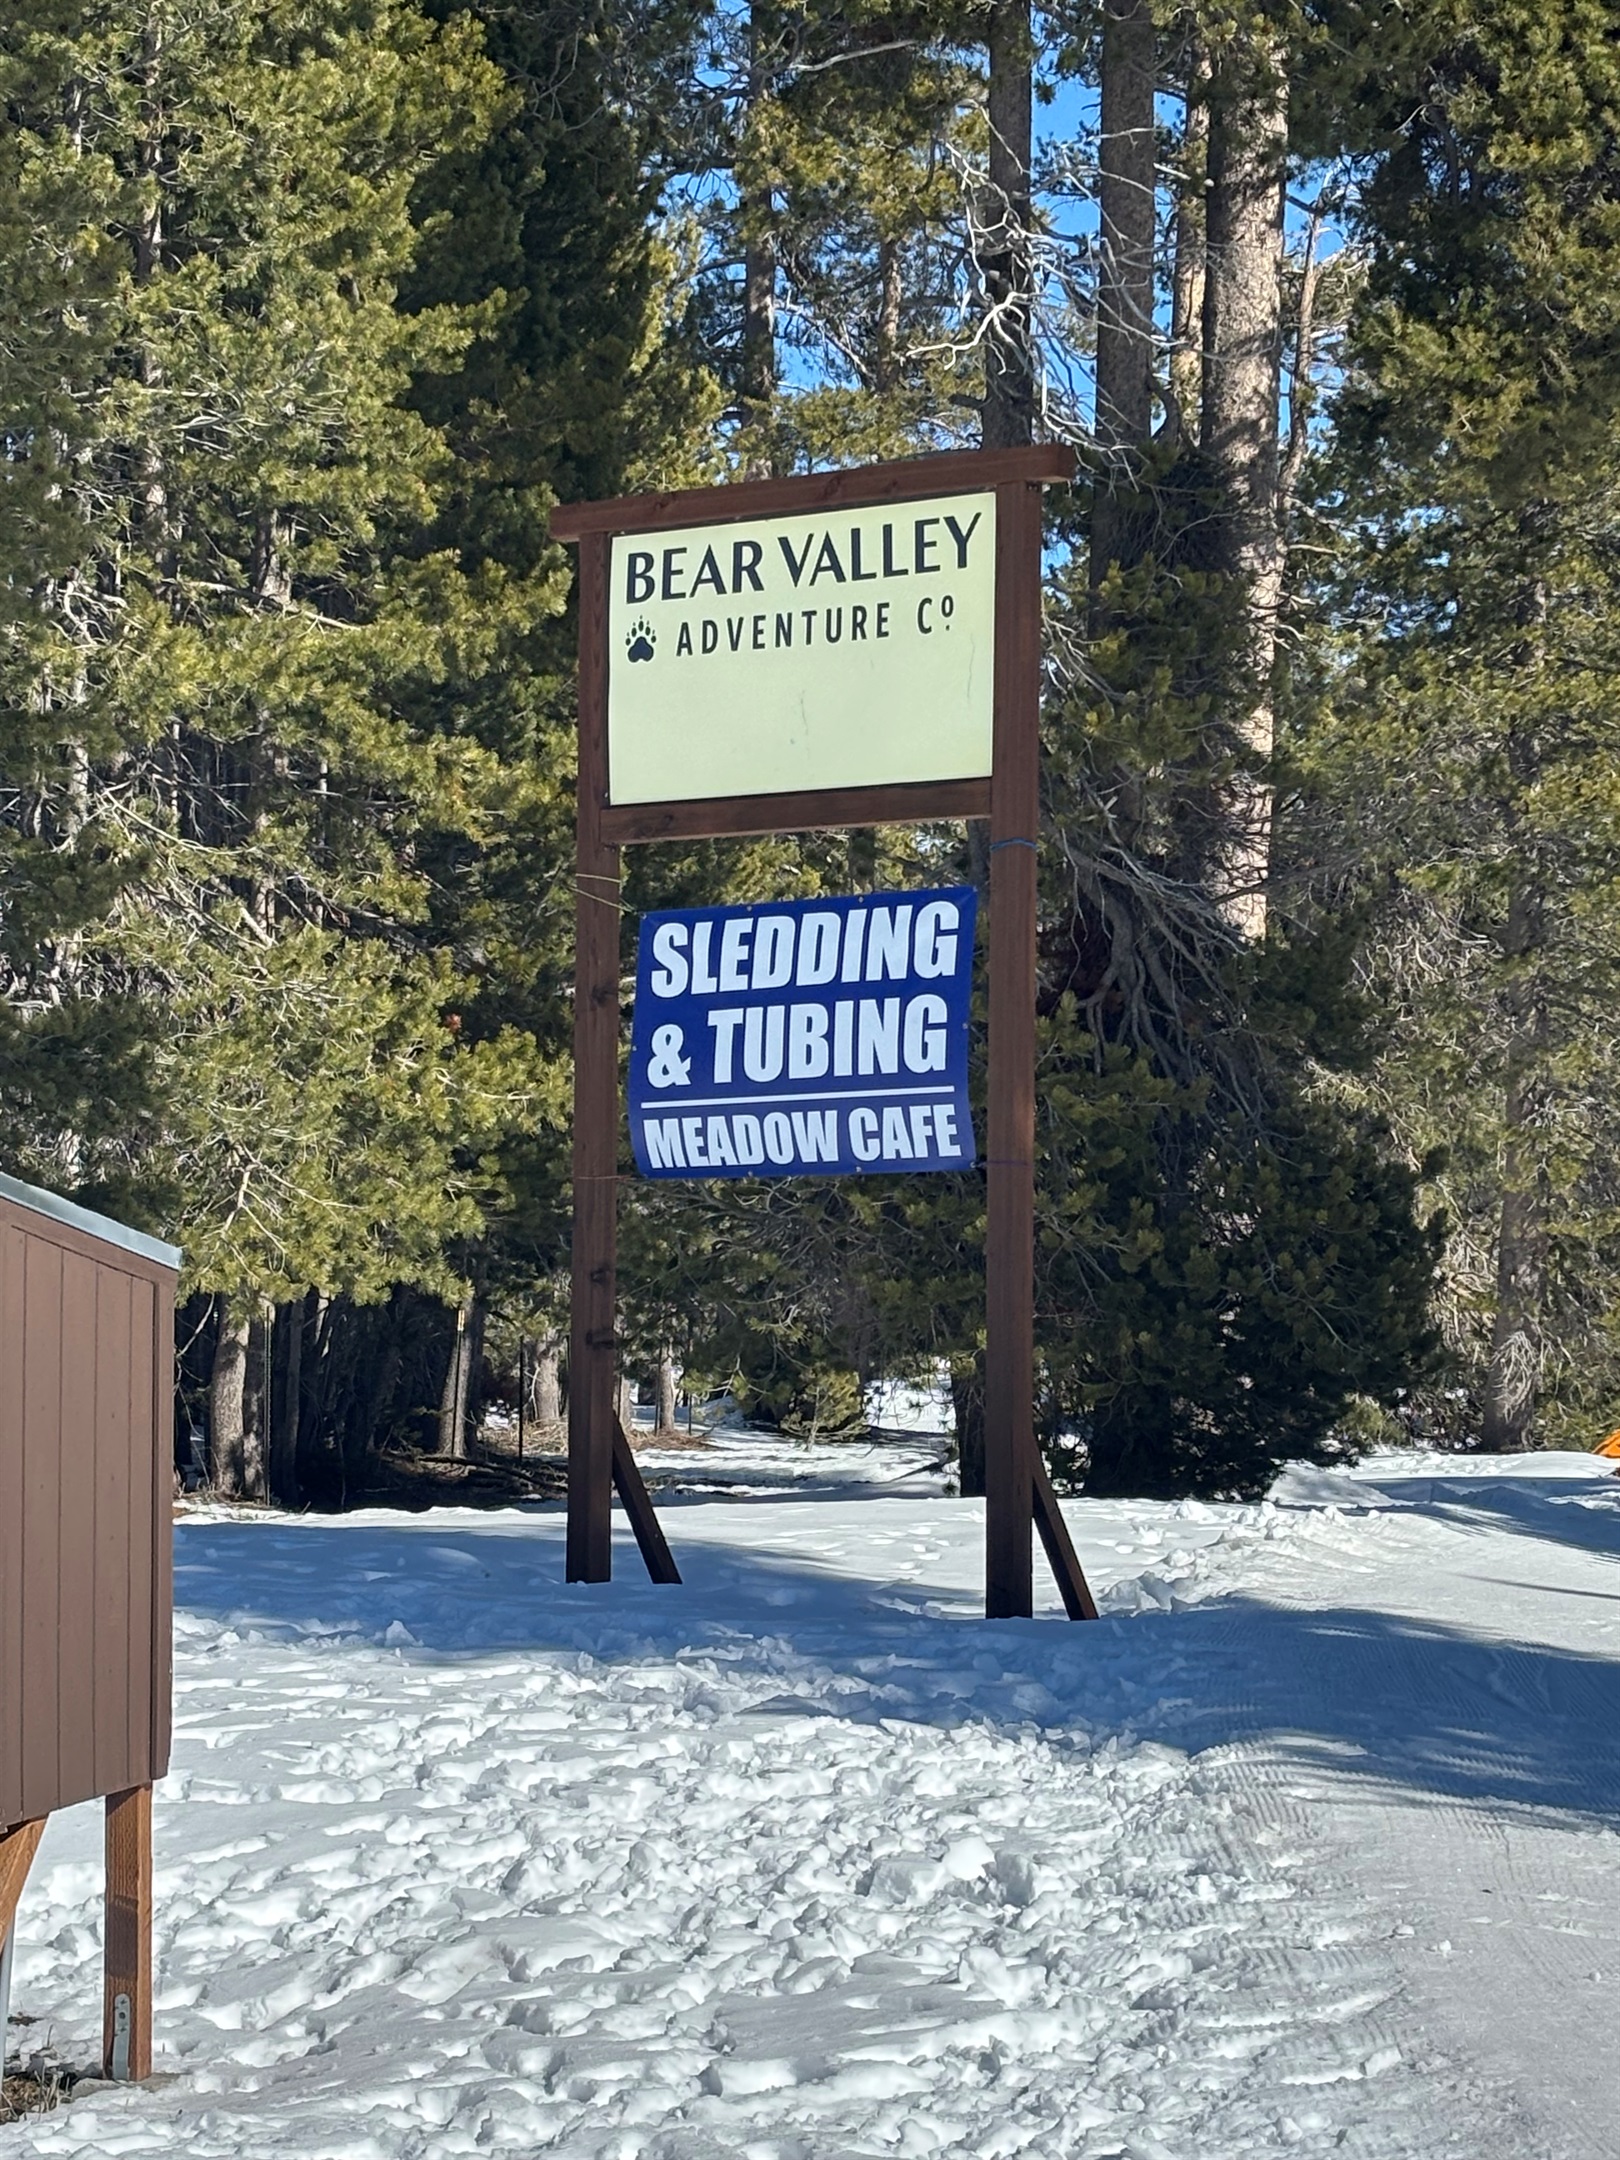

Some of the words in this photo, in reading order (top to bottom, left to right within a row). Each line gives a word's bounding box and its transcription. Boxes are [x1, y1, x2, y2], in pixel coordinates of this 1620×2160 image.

[625, 540, 765, 604] BEAR
[777, 512, 982, 588] VALLEY
[676, 602, 890, 657] ADVENTURE
[650, 900, 960, 998] SLEDDING
[647, 1024, 691, 1089] &
[707, 994, 948, 1084] TUBING
[643, 1109, 839, 1169] MEADOW
[848, 1104, 962, 1162] CAFE
